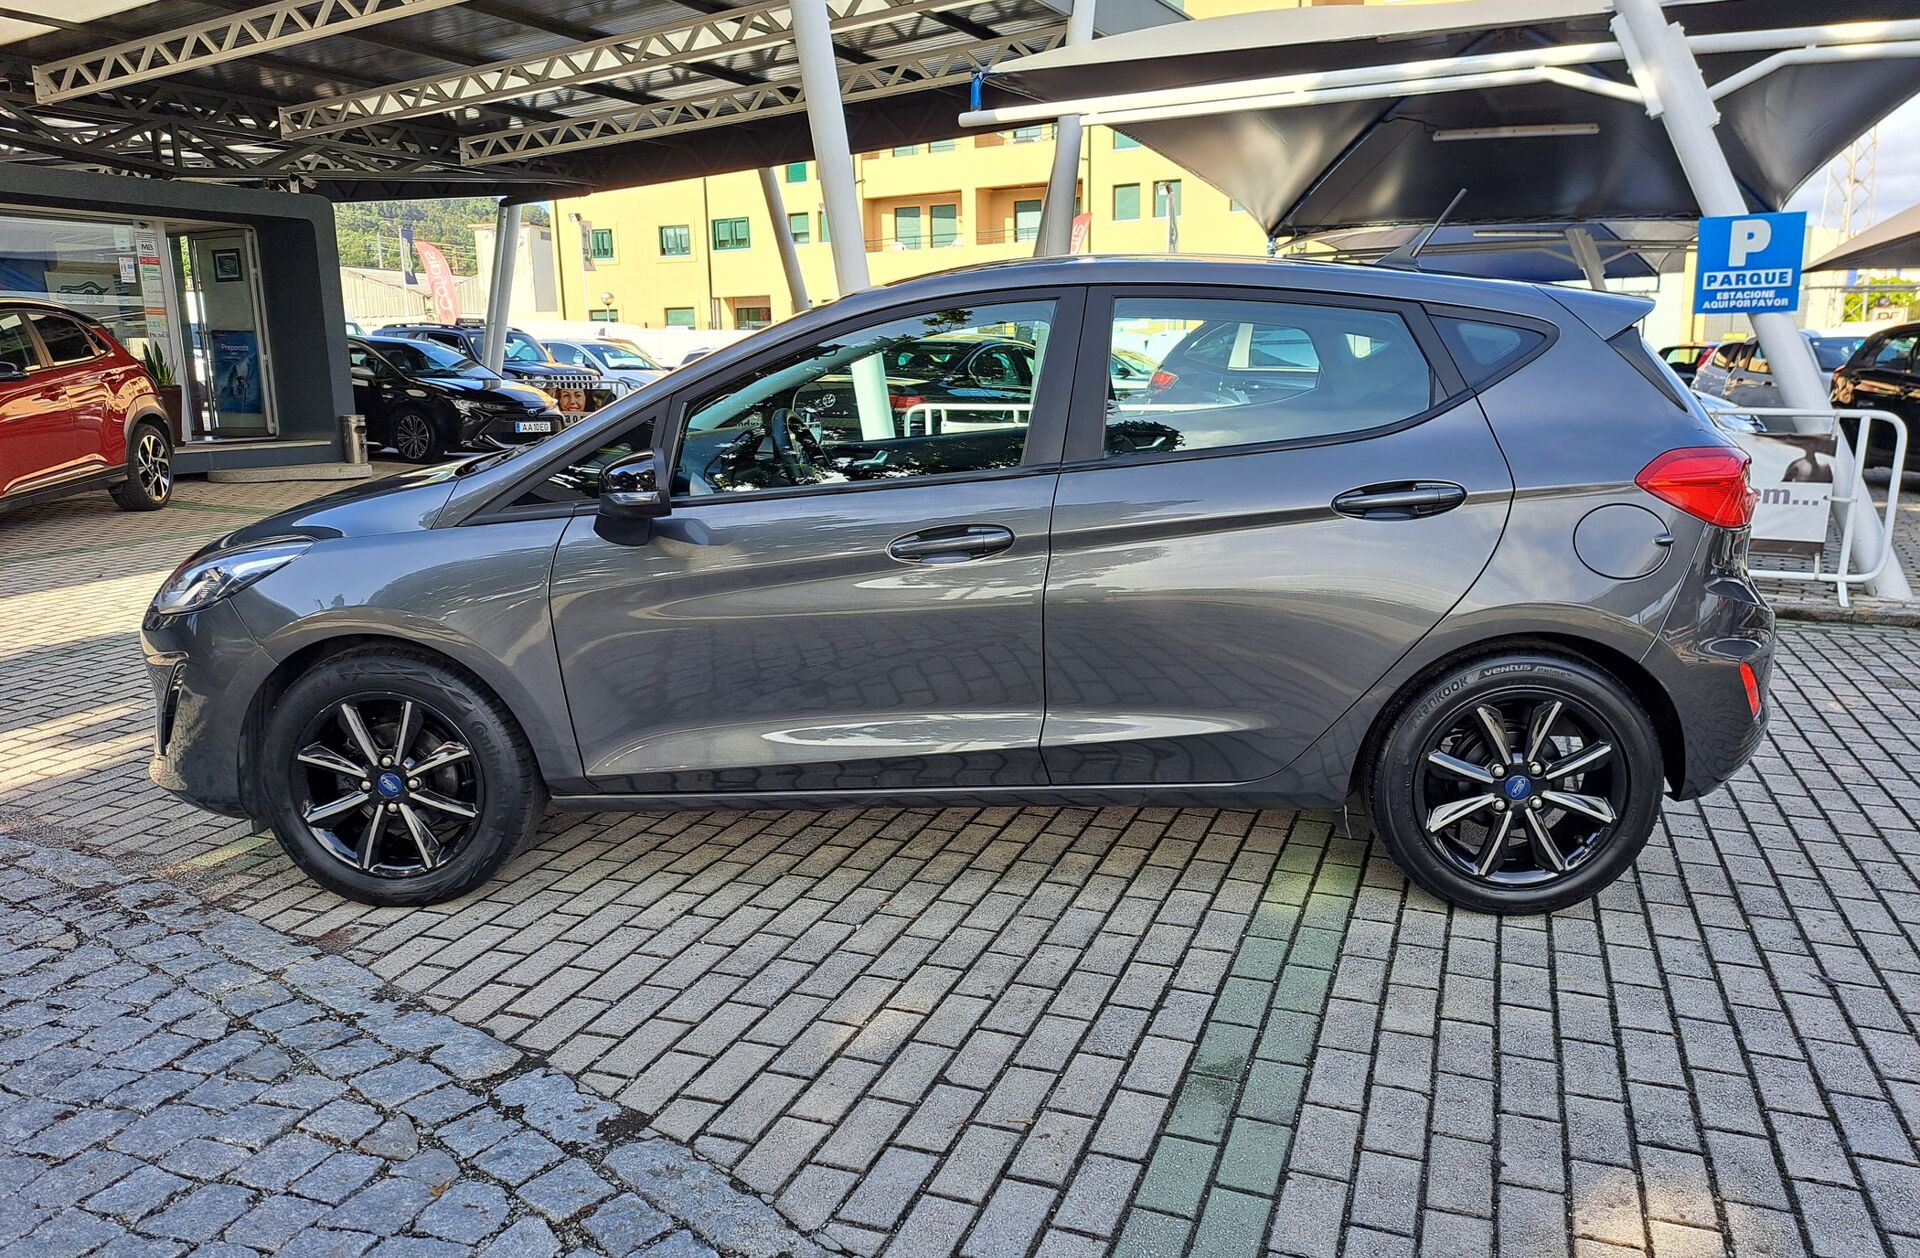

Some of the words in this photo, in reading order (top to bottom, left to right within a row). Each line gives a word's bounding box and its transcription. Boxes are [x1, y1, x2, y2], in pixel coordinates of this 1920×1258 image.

[1728, 218, 1772, 267] P
[1706, 271, 1789, 287] PARQUE
[1716, 289, 1776, 300] ESTACIONE
[1702, 301, 1729, 309] AQUI
[1729, 299, 1751, 308] POR
[1752, 298, 1789, 307] FAVOR
